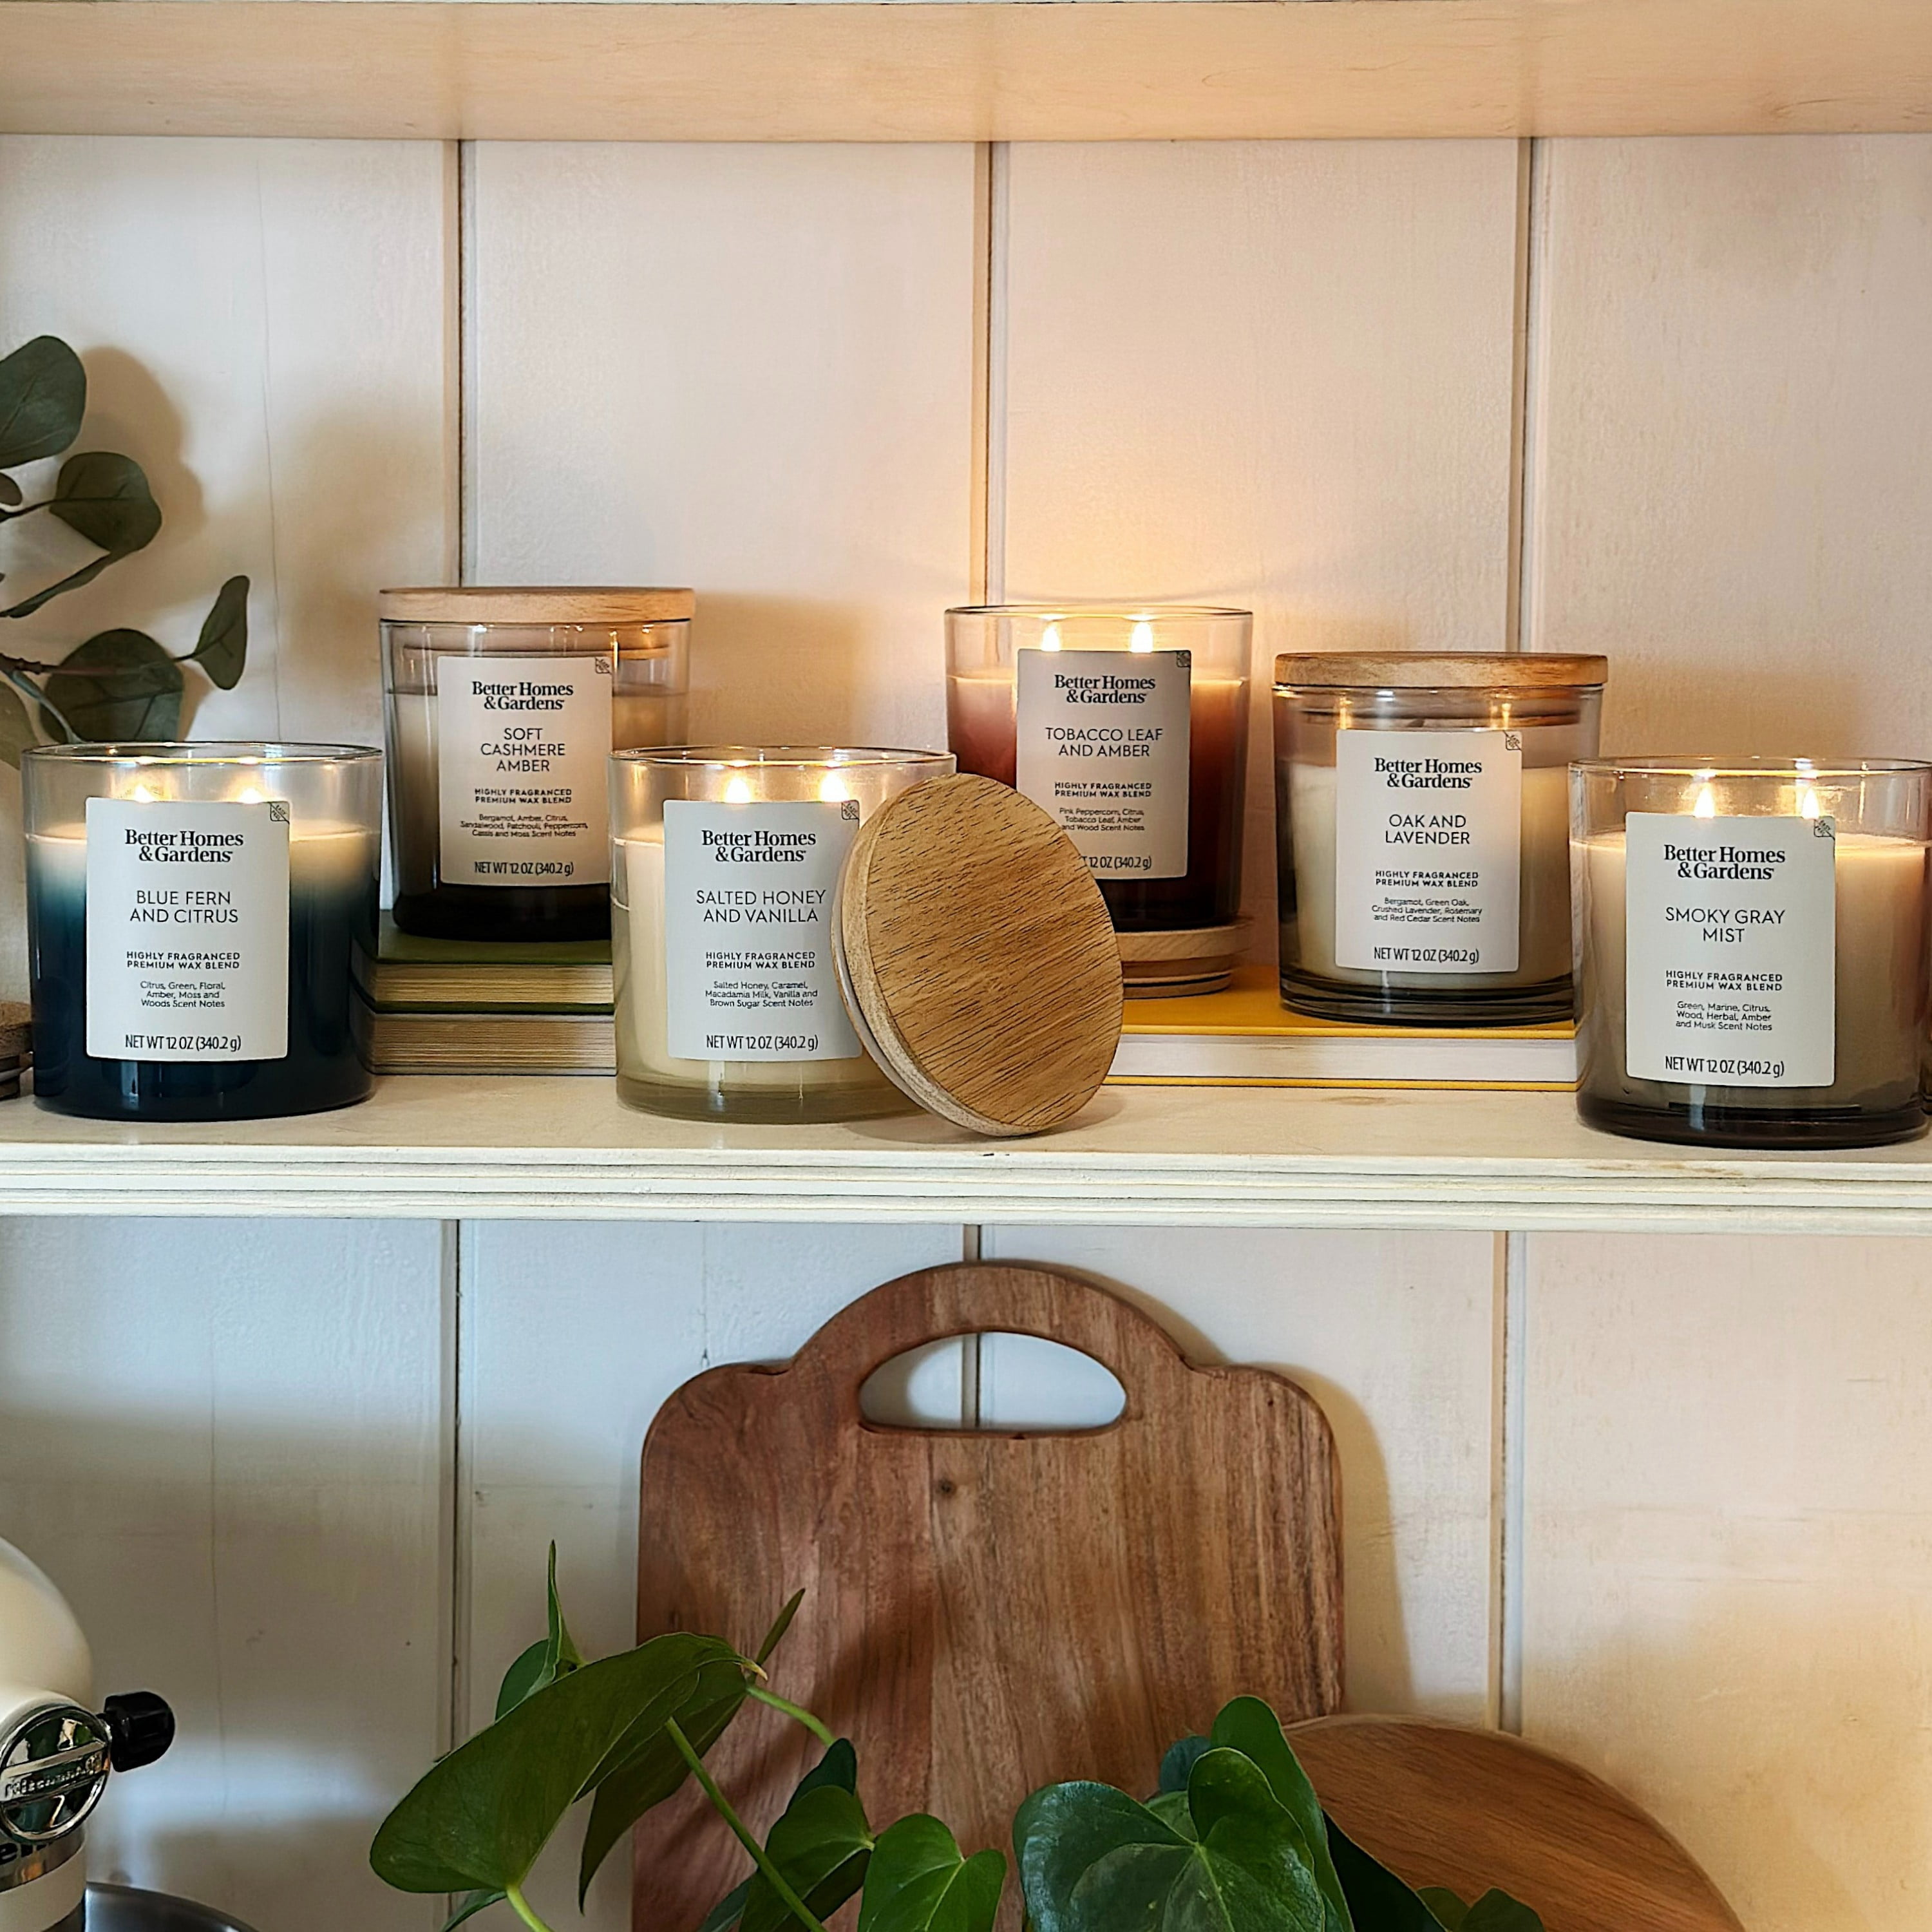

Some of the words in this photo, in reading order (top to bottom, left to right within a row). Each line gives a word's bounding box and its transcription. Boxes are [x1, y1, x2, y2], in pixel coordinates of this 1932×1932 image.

[472, 681, 517, 696] Better
[519, 683, 573, 696] Homes
[1055, 675, 1101, 689] Better
[1102, 676, 1156, 689] Homes
[504, 728, 543, 740] SOFT
[1046, 728, 1123, 741] TOBACCO
[1128, 728, 1163, 741] LEAF
[481, 743, 565, 755] CASHMERE
[1059, 745, 1093, 756] AND
[1097, 745, 1150, 757] AMBER
[497, 760, 549, 772] AMBER
[1374, 758, 1422, 773] Better
[1425, 759, 1482, 773] Homes
[1389, 814, 1425, 828] OAK
[1429, 815, 1466, 828] AND
[125, 829, 178, 846] Better
[180, 831, 243, 846] Homes
[702, 830, 752, 846] Better
[754, 831, 816, 846] Homes
[1386, 831, 1470, 844] LAVENDER
[1664, 845, 1717, 861] Better
[1719, 847, 1785, 863] Homes
[475, 862, 491, 873] NET
[493, 862, 507, 873] WT
[509, 863, 519, 874] 12
[521, 863, 533, 874] OZ
[1089, 857, 1098, 868] 12
[1100, 857, 1112, 868] OZ
[137, 891, 178, 904] BLUE
[186, 891, 230, 905] FERN
[697, 891, 756, 904] SALTED
[763, 890, 826, 904] HONEY
[130, 909, 169, 922] AND
[175, 909, 238, 923] CITRUS
[704, 909, 740, 922] AND
[745, 908, 819, 922] VANILLA
[1666, 907, 1730, 923] SMOKY
[1735, 910, 1785, 923] GRAY
[1703, 928, 1745, 942] MIST
[127, 951, 164, 960] HIGHLY
[1374, 947, 1391, 959] NET
[1394, 948, 1410, 960] WT
[1411, 949, 1421, 960] 12
[1424, 949, 1436, 961] OZ
[1707, 973, 1783, 981] FRAGRANCED
[1667, 980, 1714, 989] PREMIUM
[737, 1000, 759, 1009] Sugar
[126, 1035, 144, 1048] NET
[147, 1036, 164, 1049] WT
[166, 1037, 176, 1049] 12
[179, 1037, 193, 1049] OZ
[706, 1035, 724, 1048] NET
[727, 1036, 744, 1049] WT
[746, 1037, 756, 1049] 12
[758, 1036, 772, 1049] OZ
[1665, 1056, 1685, 1070] NET
[1687, 1058, 1705, 1072] WT
[1707, 1060, 1717, 1073] 12
[1720, 1060, 1735, 1074] OZ
